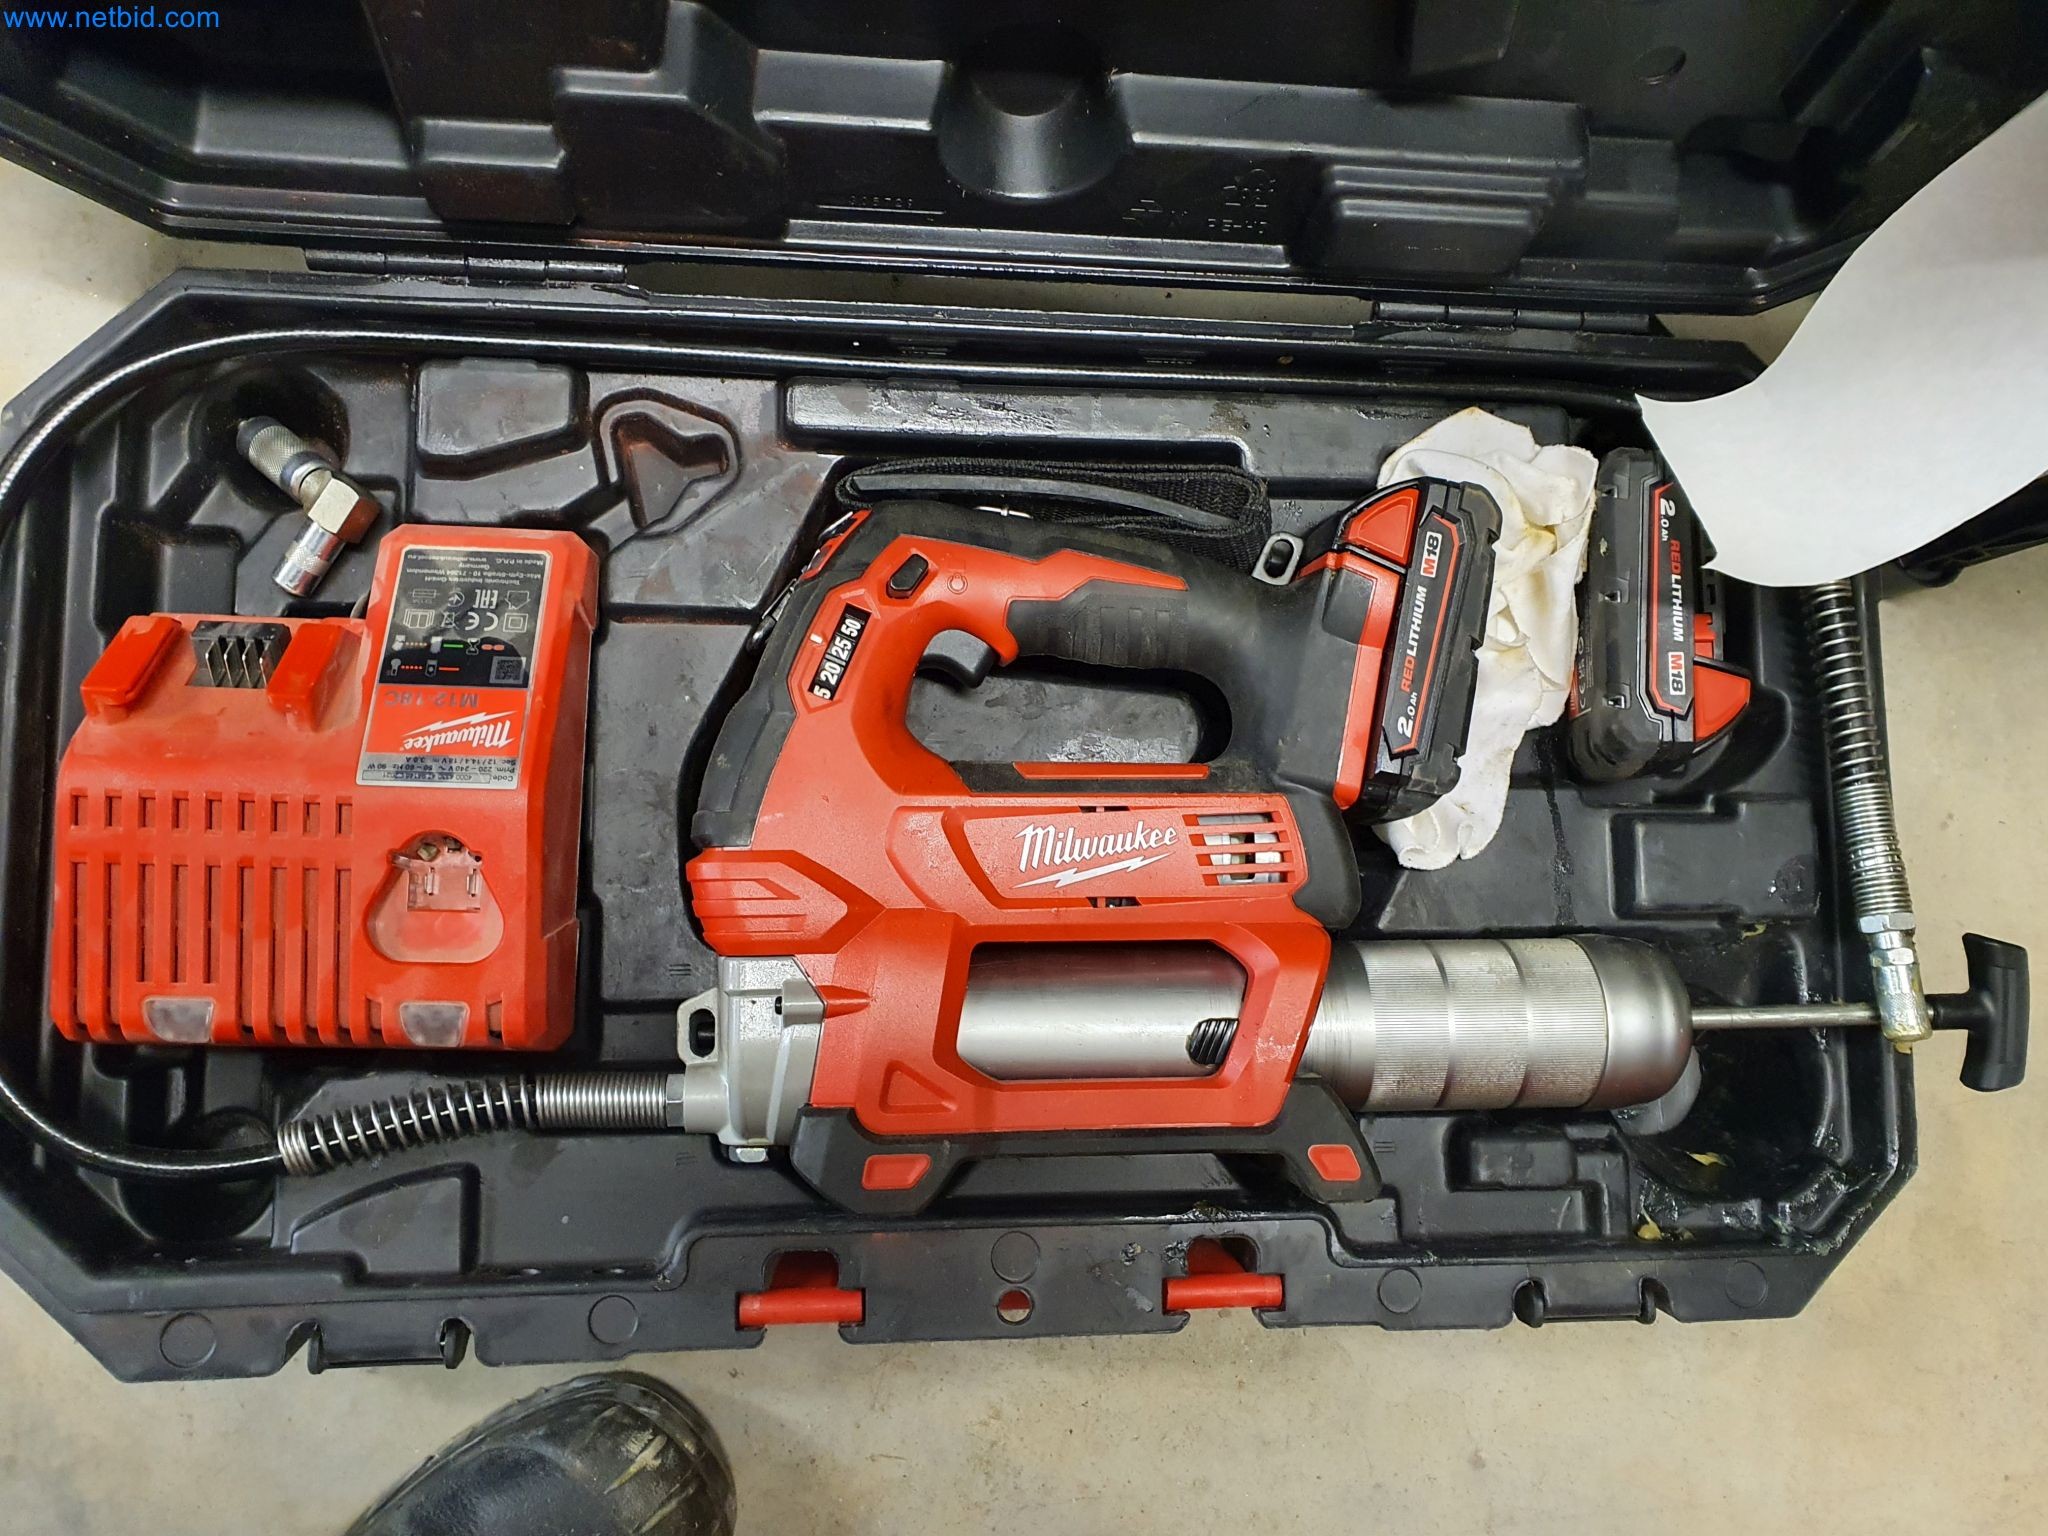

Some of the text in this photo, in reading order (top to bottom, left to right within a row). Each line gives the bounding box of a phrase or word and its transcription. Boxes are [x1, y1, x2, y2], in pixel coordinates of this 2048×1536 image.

[1423, 534, 1440, 575] M18
[1669, 539, 1684, 642] REDLITHIUM
[820, 662, 840, 685] 20
[831, 637, 851, 660] 25
[841, 619, 861, 637] 50
[1401, 585, 1427, 692] REDLITHIUM
[1671, 654, 1683, 693] M18
[403, 720, 515, 752] Milwaukee
[1012, 820, 1178, 872] Milwaukee
